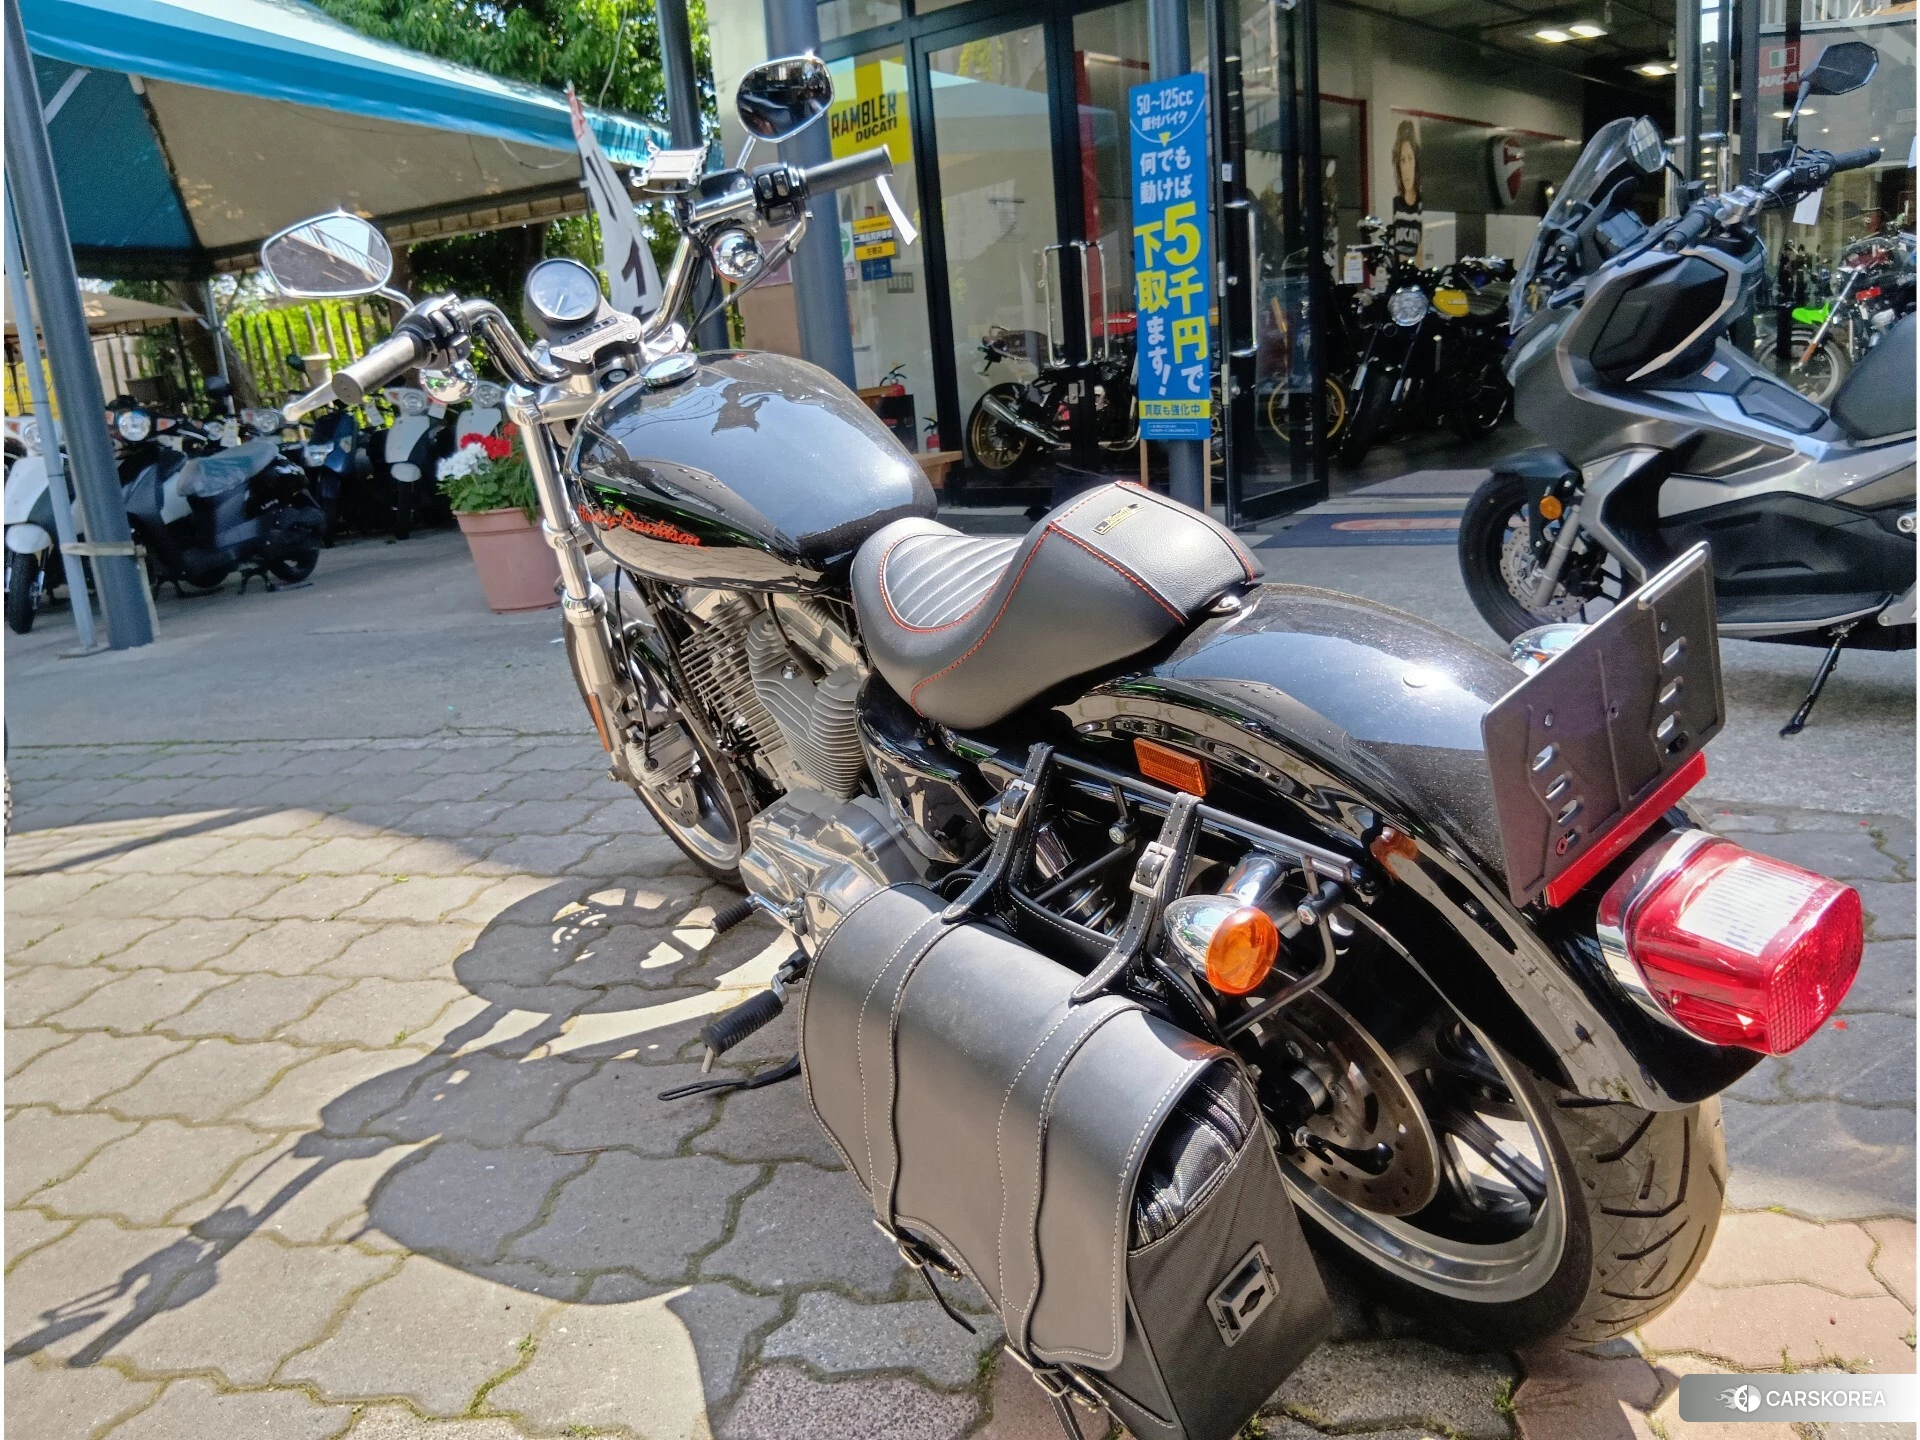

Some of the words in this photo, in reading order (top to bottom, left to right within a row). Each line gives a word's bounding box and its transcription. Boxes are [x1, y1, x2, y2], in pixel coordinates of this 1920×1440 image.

[856, 116, 897, 143] DUCATI
[1140, 145, 1191, 177] 何でも
[1140, 173, 1193, 205] 動けば
